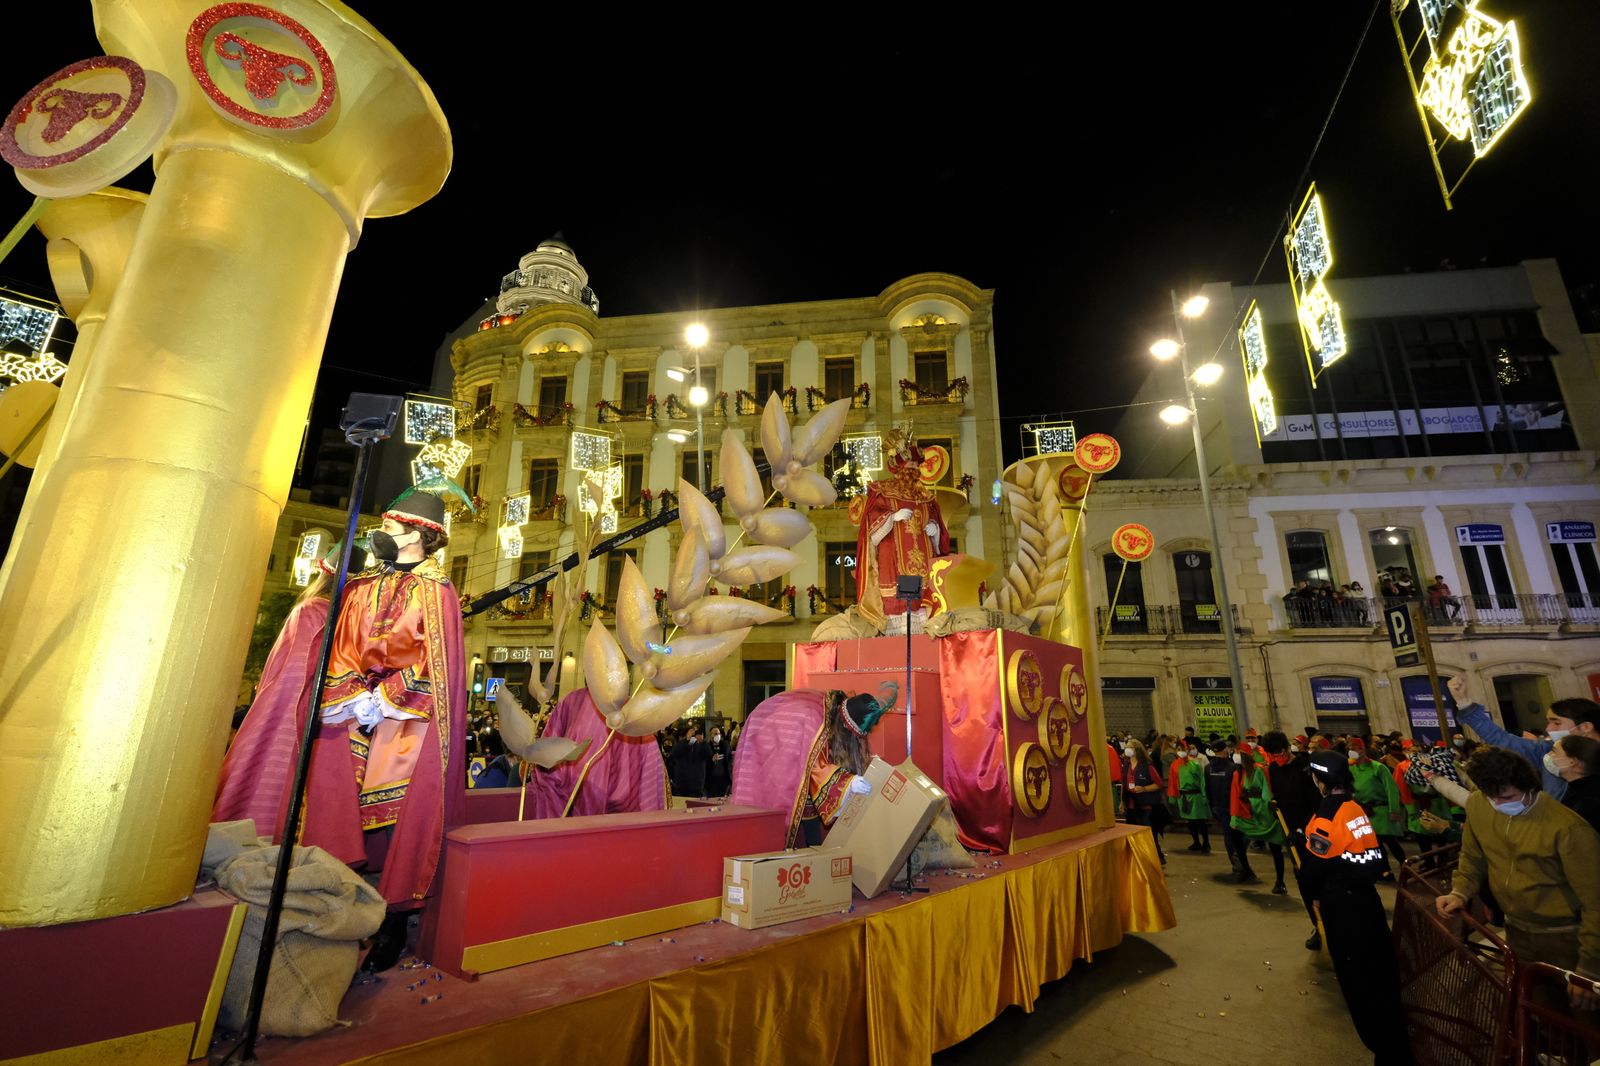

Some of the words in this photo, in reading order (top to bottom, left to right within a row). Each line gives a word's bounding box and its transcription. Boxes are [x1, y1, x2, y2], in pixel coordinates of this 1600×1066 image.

[1288, 423, 1314, 433] G&M
[1323, 418, 1396, 430] CONSULTORES
[1405, 417, 1412, 426] Y
[1421, 414, 1481, 425] BOGADOS
[1194, 695, 1204, 705] SE
[1205, 695, 1231, 705] VENDE
[1195, 707, 1201, 717] O
[1203, 707, 1233, 717] ALQUILA
